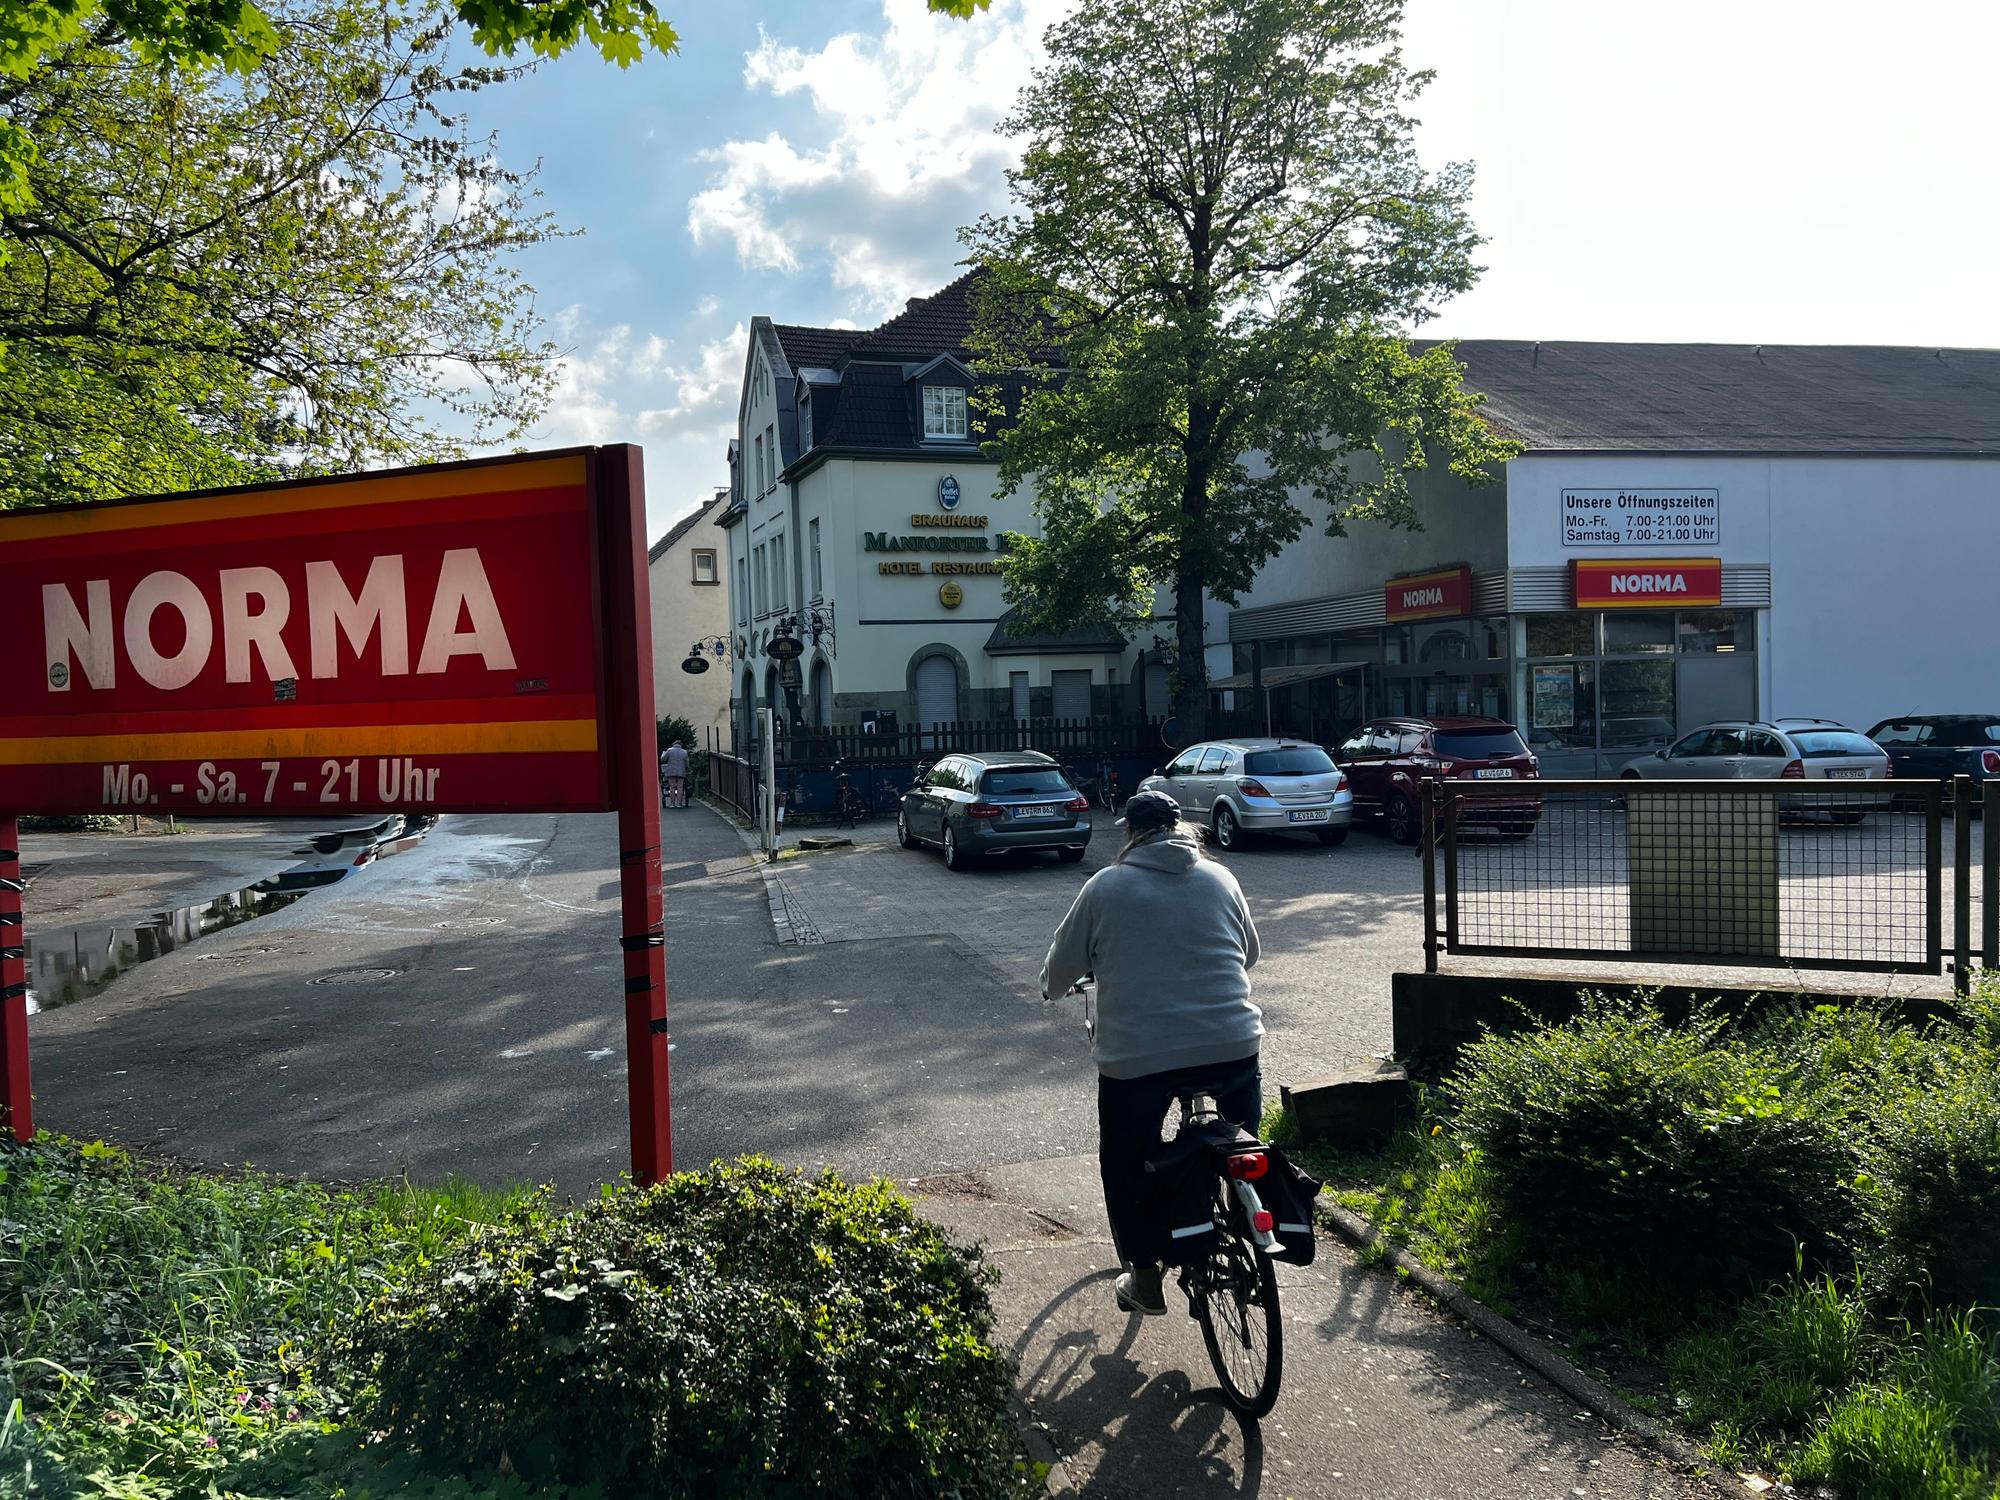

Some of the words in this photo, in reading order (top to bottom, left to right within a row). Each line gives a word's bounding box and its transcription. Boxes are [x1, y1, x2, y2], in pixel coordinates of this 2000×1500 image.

[1566, 495, 1612, 509] Unsere
[1617, 491, 1715, 511] Öffnungszeiten
[912, 514, 988, 529] BRAUHAUS
[1566, 515, 1608, 527] Mo.-Fr.
[1626, 515, 1690, 527] 7.00-21.00
[1694, 515, 1715, 526] Uhr
[1567, 529, 1620, 543] Samstag
[1626, 529, 1690, 541] 7.00-21.00
[1694, 528, 1715, 540] Uhr
[879, 562, 925, 575] HOTEL
[1611, 574, 1688, 593] NORMA
[1403, 587, 1444, 609] NORMA
[42, 546, 517, 693] NORMA
[102, 763, 159, 805] Mo.
[197, 761, 247, 804] Sa.
[261, 761, 281, 803] 7
[319, 759, 360, 803] 21
[378, 758, 441, 803] Uhr
